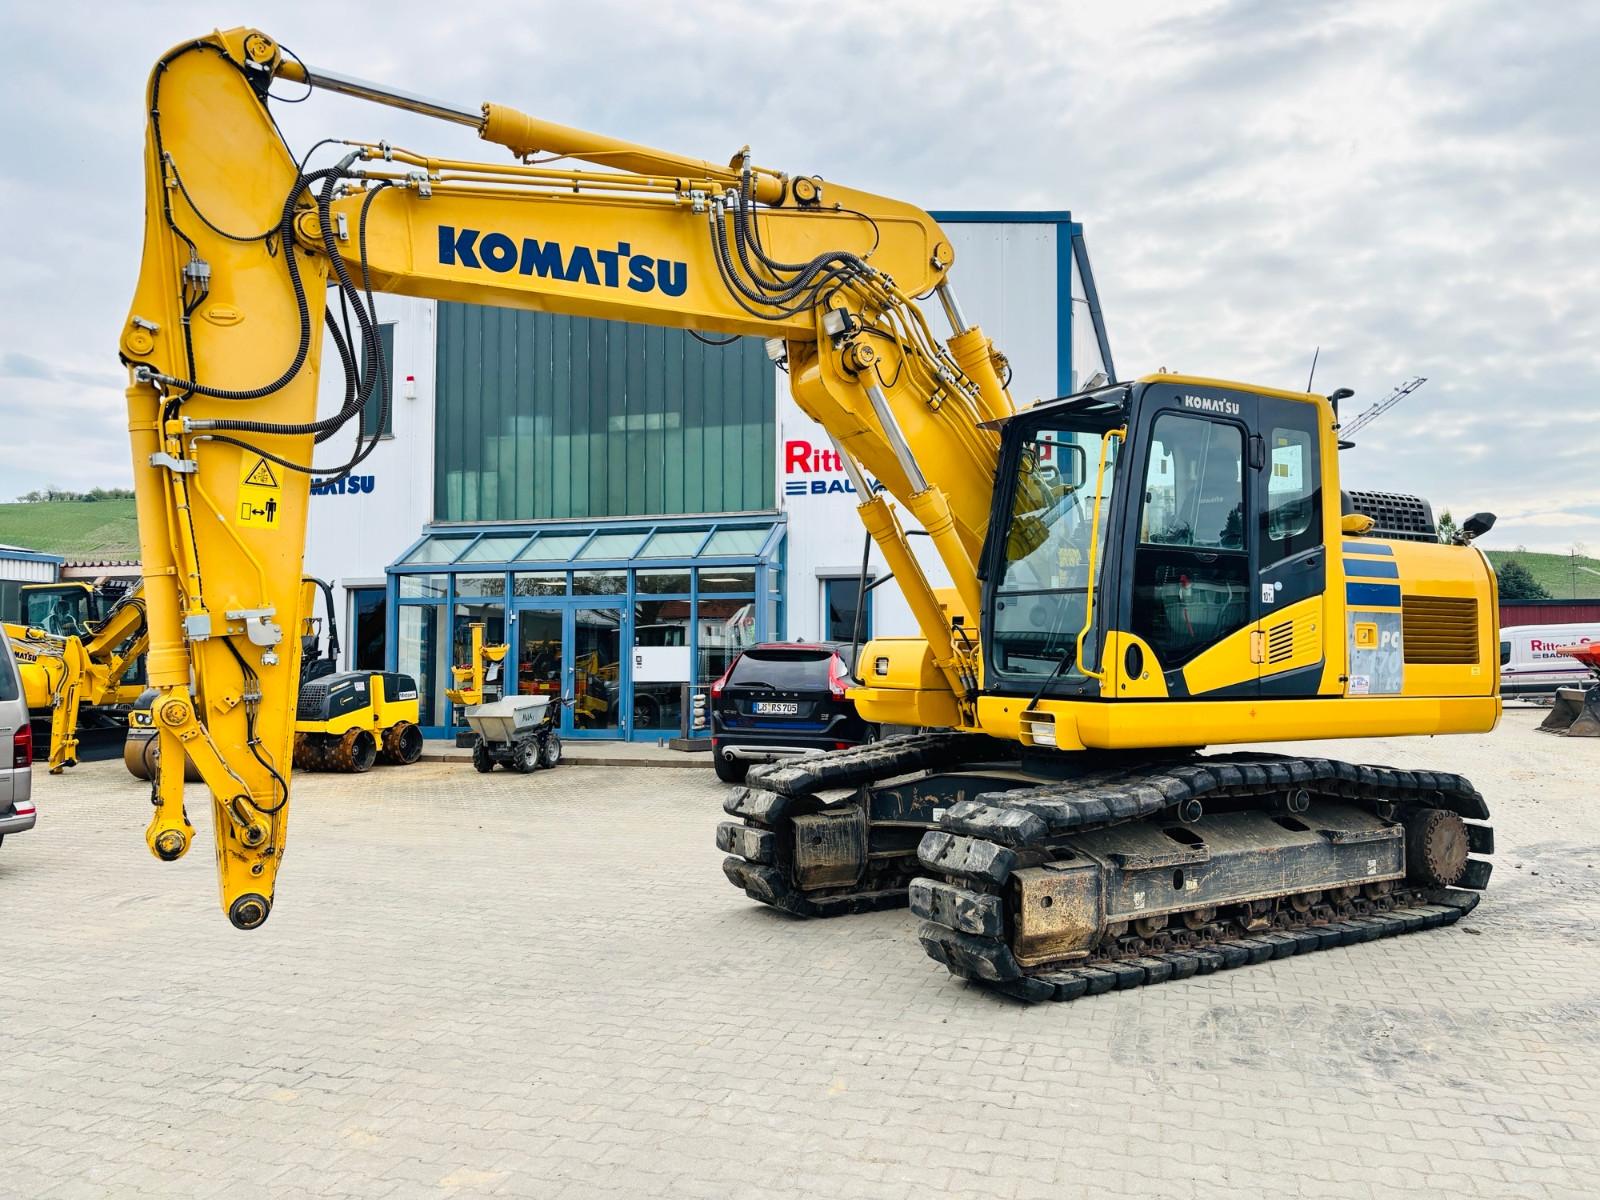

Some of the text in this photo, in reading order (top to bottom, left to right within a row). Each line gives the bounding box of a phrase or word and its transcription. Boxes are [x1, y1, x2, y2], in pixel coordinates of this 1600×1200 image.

[438, 225, 688, 297] KOMATSU
[1185, 395, 1240, 415] KOMATSU
[1381, 631, 1399, 648] PC
[771, 703, 782, 712] RS
[782, 703, 797, 712] 705
